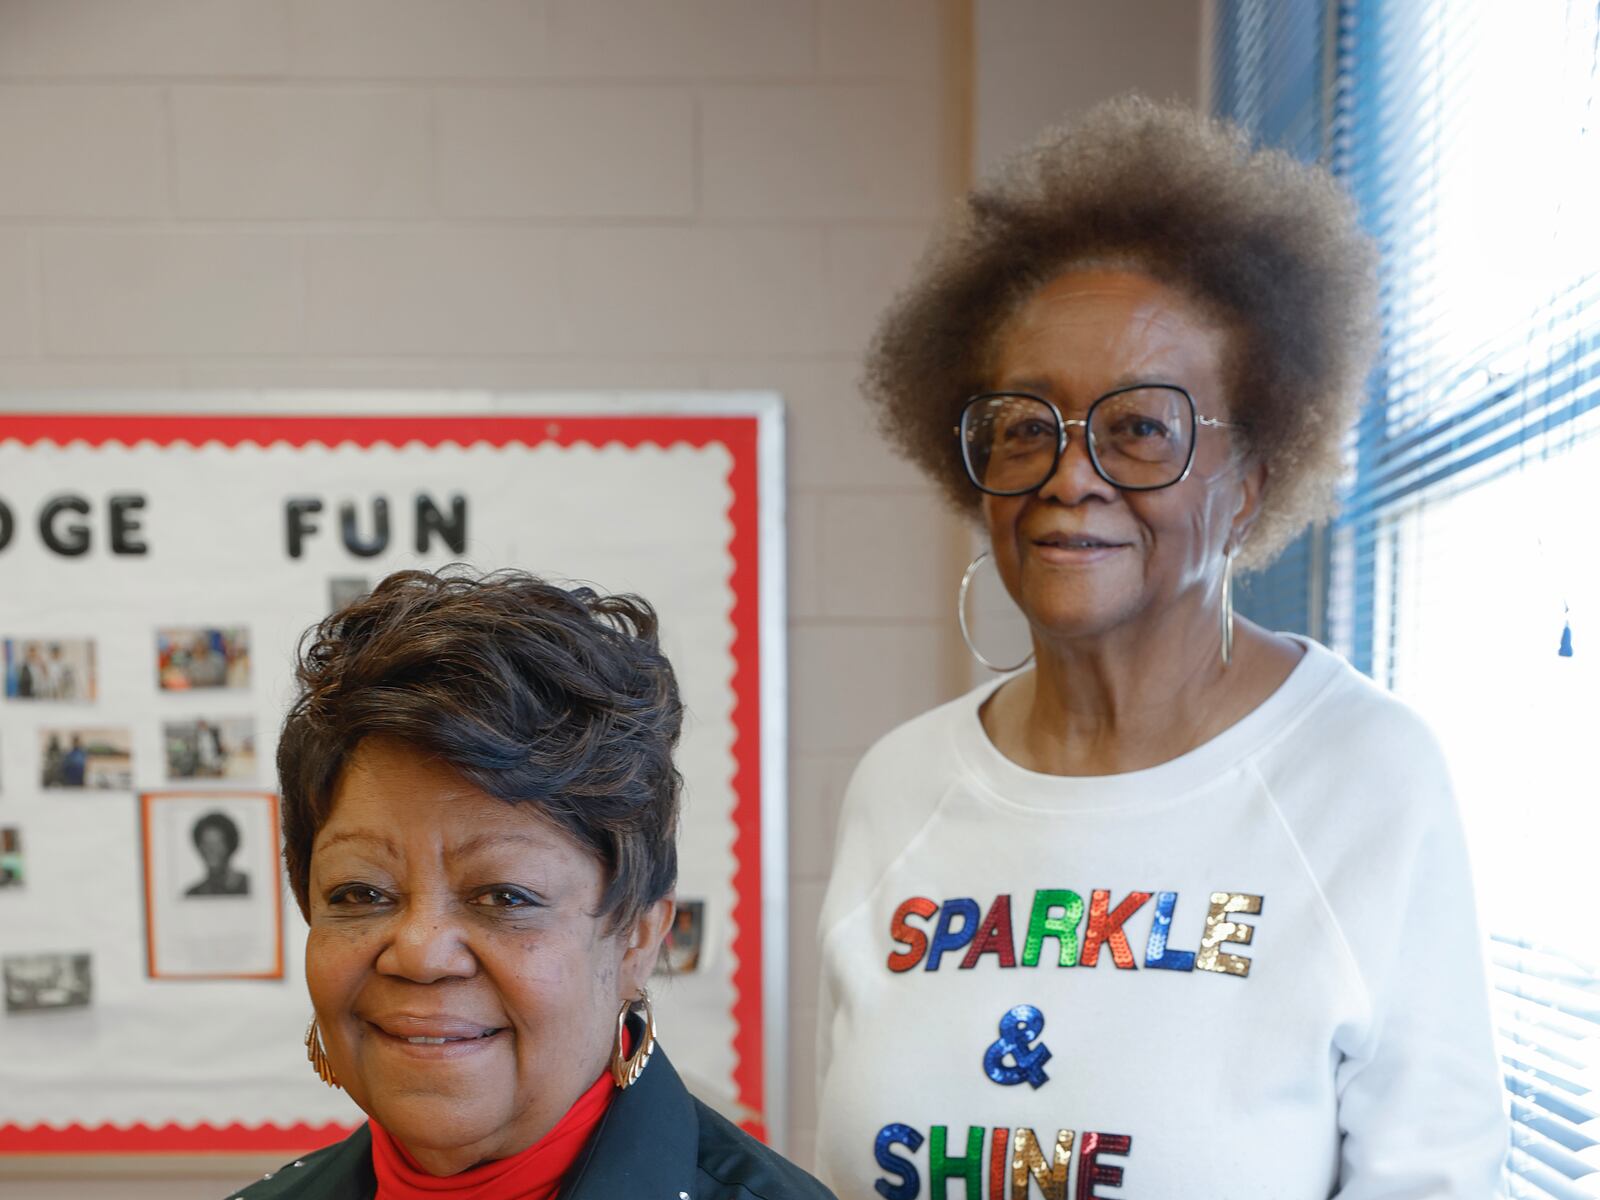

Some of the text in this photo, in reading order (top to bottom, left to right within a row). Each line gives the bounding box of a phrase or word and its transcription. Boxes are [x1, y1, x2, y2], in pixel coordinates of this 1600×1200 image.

[0, 495, 467, 558] GE FUN
[887, 888, 1265, 977] SPARKLE
[983, 1004, 1053, 1089] &
